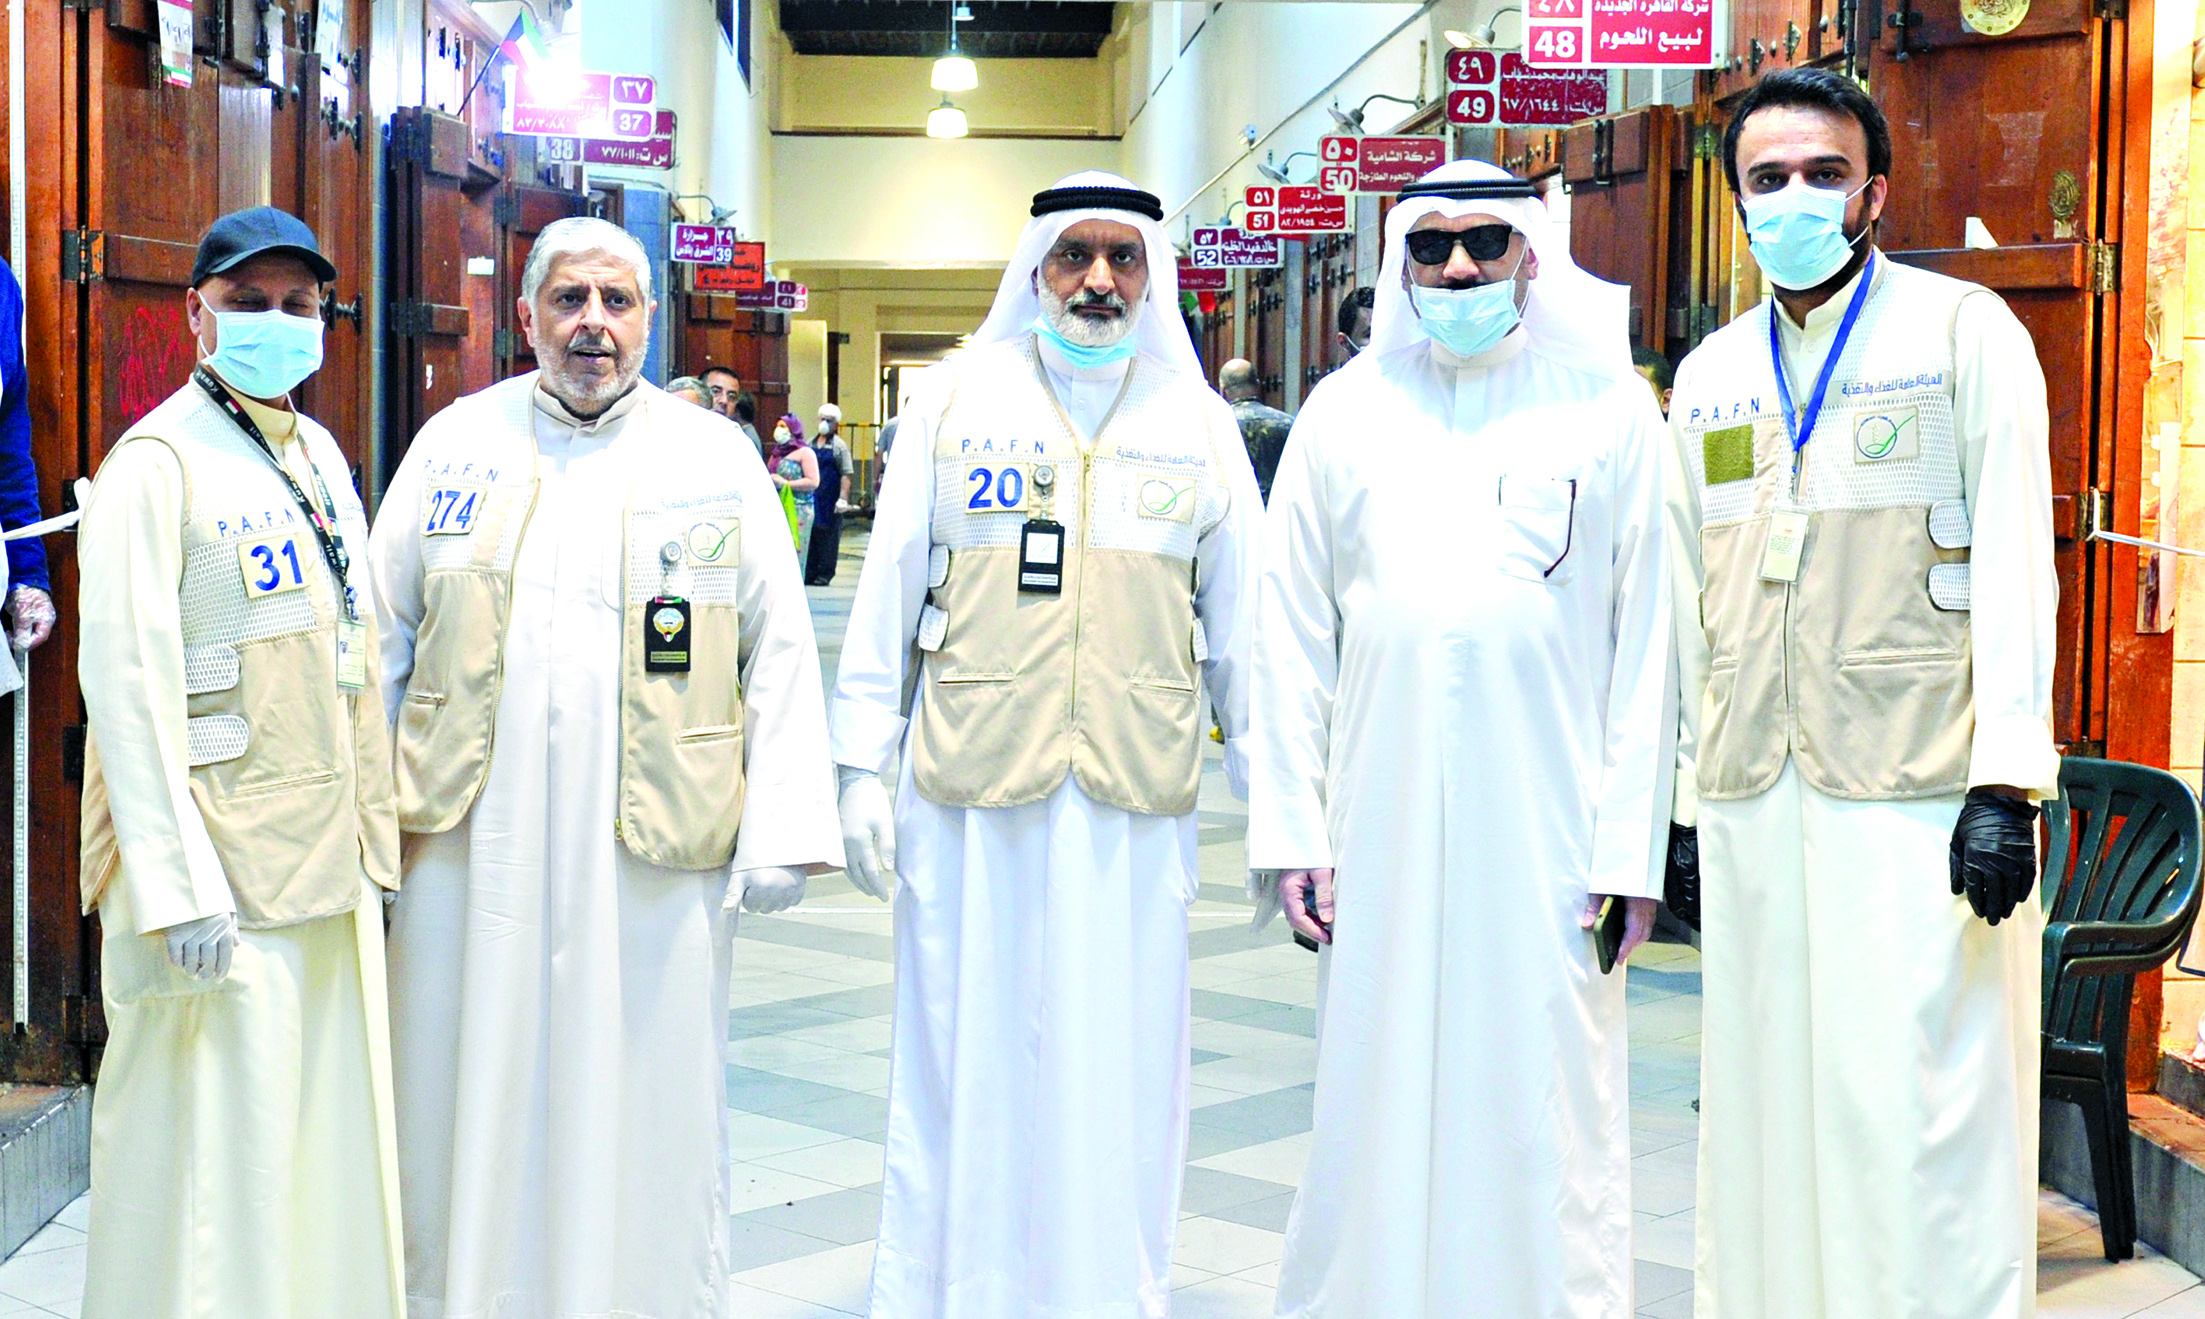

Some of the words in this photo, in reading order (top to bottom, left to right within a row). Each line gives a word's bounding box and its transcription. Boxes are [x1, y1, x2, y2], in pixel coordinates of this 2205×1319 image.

[1534, 30, 1576, 58] 48
[1599, 27, 1653, 50] اللحوم
[1657, 28, 1703, 52] لبيع
[1458, 56, 1484, 80] ٤٩
[621, 80, 647, 99] ٣٧
[1456, 97, 1486, 118] 49
[619, 113, 644, 131] 37
[551, 138, 574, 160] 38
[1326, 139, 1354, 160] ٥٠
[1367, 150, 1402, 164] الشامية
[1404, 150, 1436, 164] شركة
[1325, 169, 1353, 190] 50
[1254, 191, 1270, 204] ٥١
[1253, 213, 1268, 228] 51
[717, 229, 734, 244] ٣٩
[1200, 232, 1213, 244] ٥٢
[716, 247, 732, 261] 39
[1196, 250, 1216, 265] 52
[780, 297, 793, 306] 41
[968, 467, 1023, 509] 20
[426, 490, 477, 532] 274
[249, 539, 304, 592] 31
